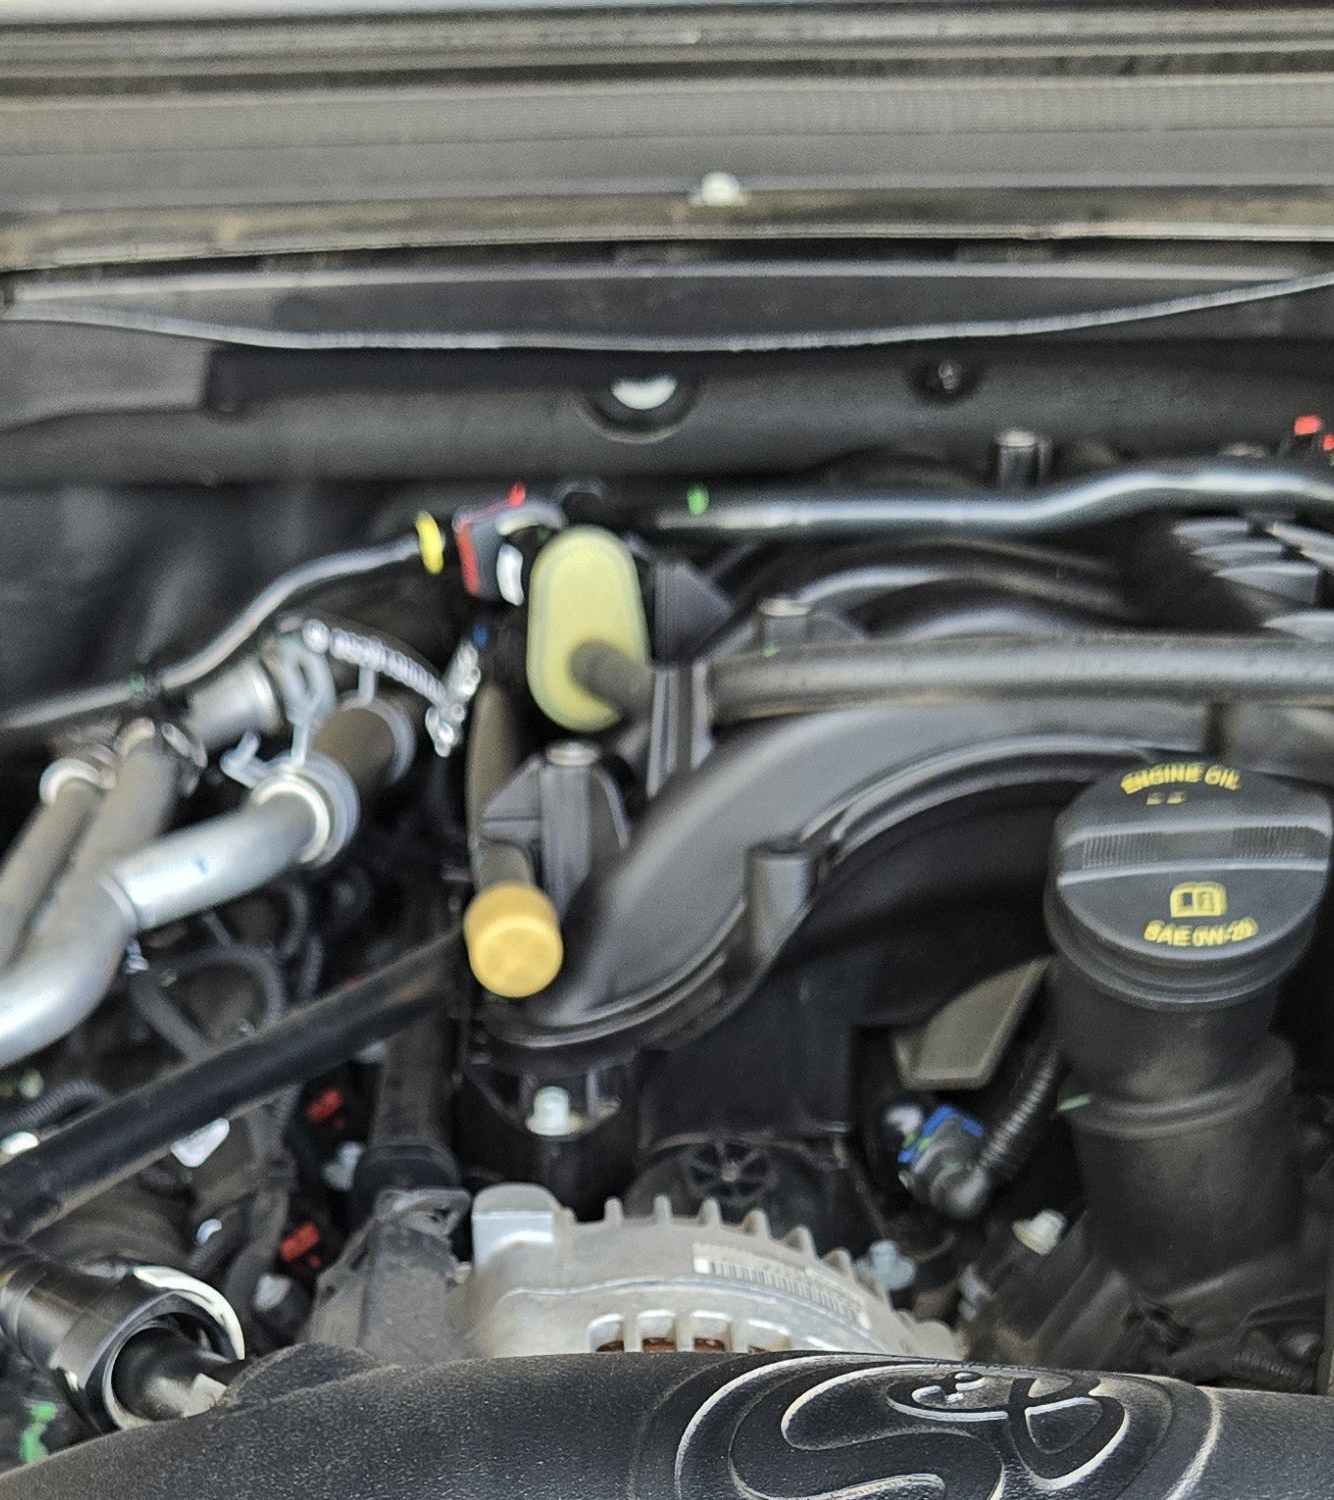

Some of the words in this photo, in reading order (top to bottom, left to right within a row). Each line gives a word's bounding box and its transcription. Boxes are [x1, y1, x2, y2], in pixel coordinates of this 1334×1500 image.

[1120, 762, 1204, 794] ENGINE
[1204, 764, 1241, 791] OIL
[1144, 919, 1192, 947] SAE
